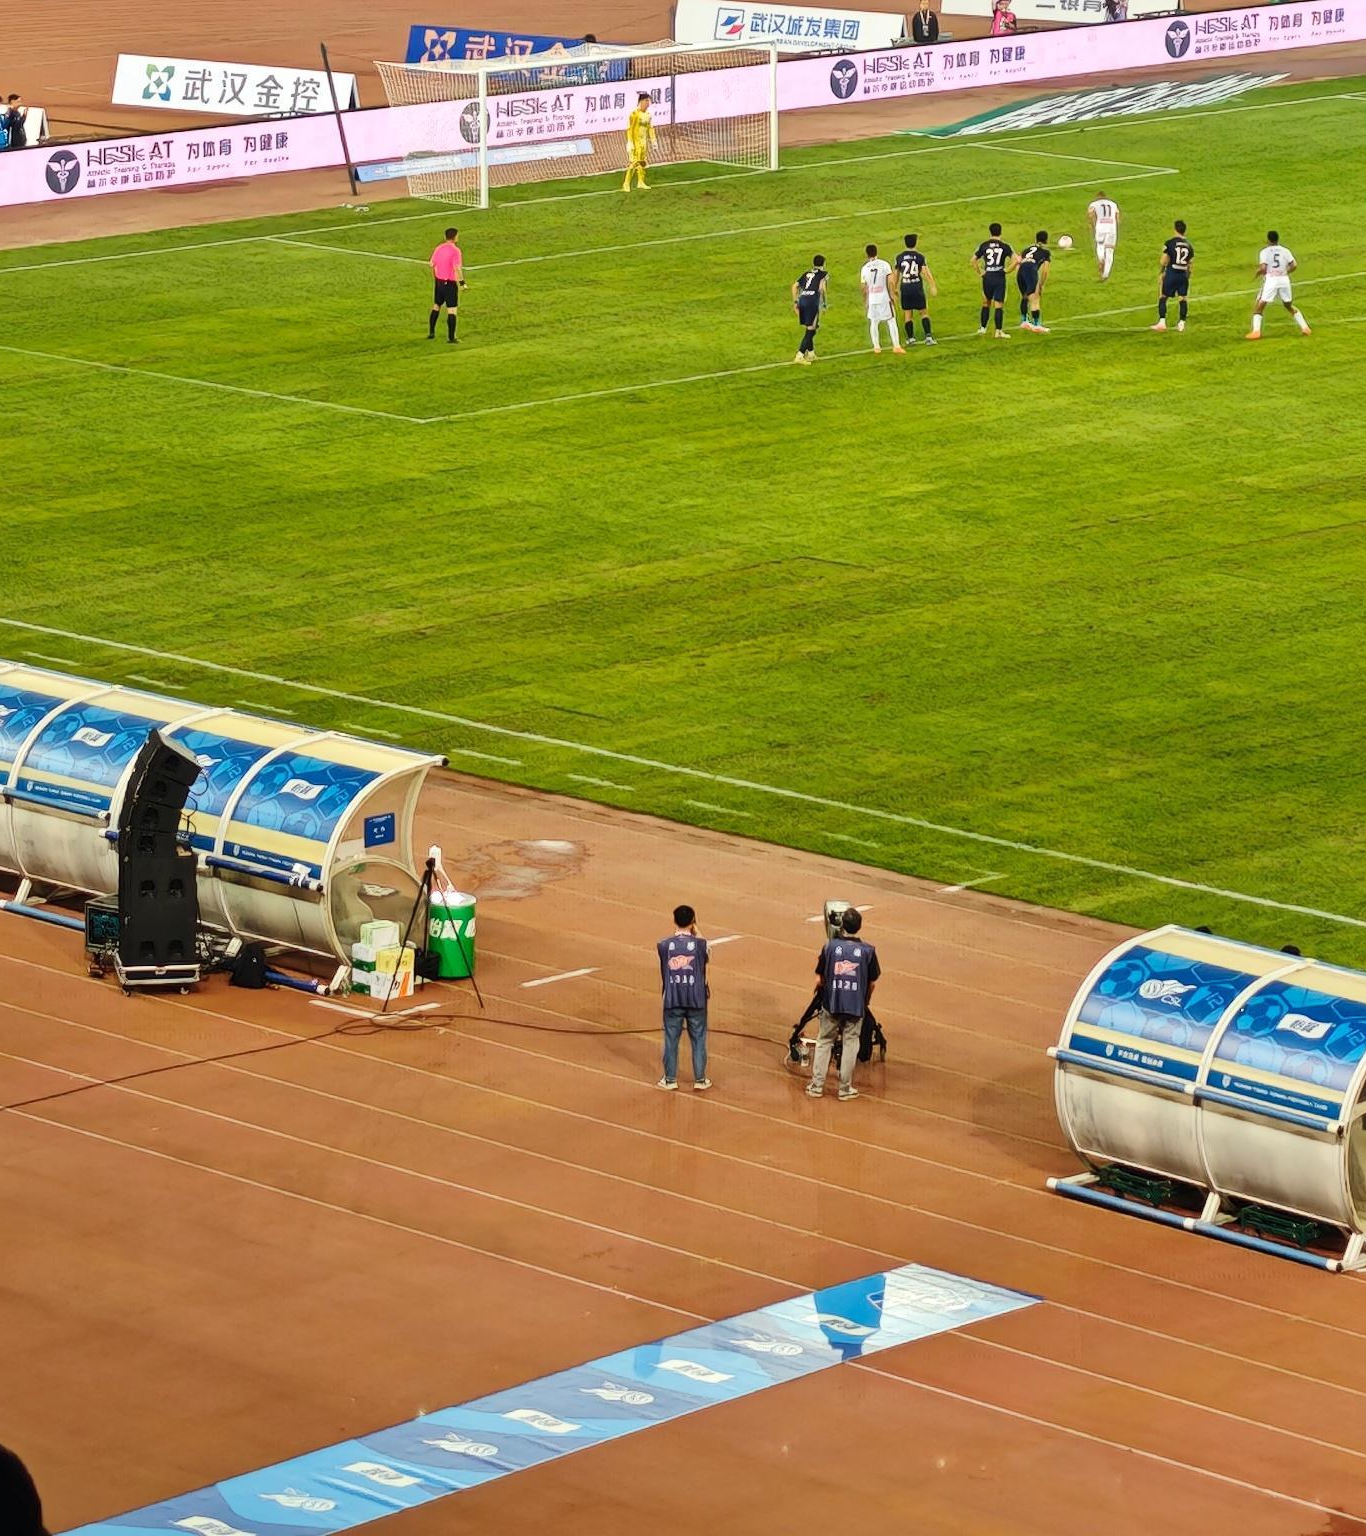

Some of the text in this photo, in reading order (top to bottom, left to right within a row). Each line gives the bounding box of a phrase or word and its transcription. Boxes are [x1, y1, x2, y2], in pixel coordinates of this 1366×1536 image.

[750, 12, 860, 41] 武汉城发集团
[182, 69, 322, 112] 武汉金控
[985, 248, 1004, 265] 37
[1175, 246, 1189, 265] 12
[1272, 253, 1281, 268] 5
[901, 262, 919, 278] 24
